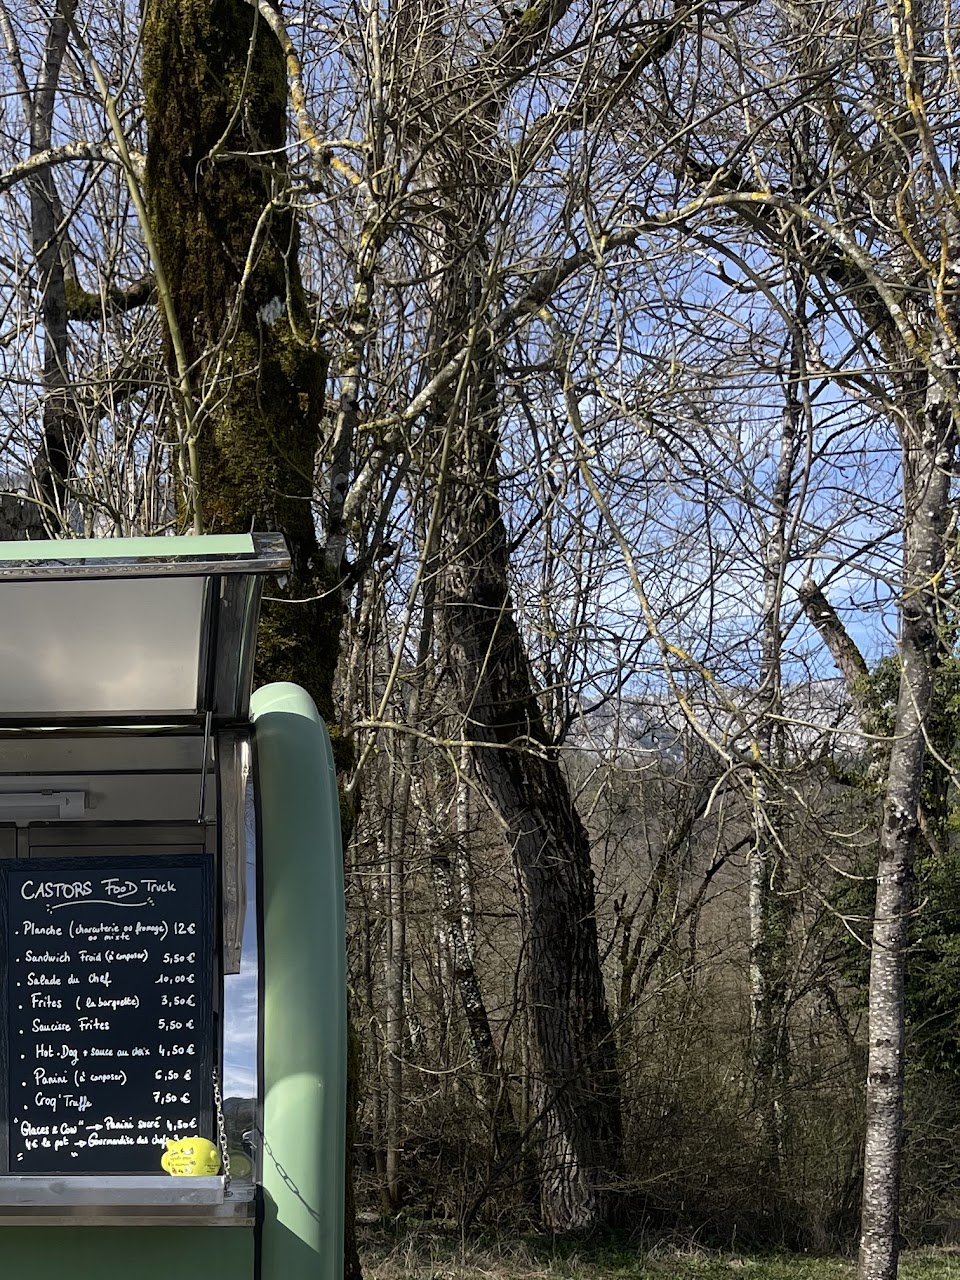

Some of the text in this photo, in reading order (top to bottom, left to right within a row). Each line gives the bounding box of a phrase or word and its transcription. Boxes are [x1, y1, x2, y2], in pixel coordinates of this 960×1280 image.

[21, 880, 92, 900] CASTORS
[23, 920, 62, 936] Planche
[174, 922, 196, 935] 12€
[104, 932, 130, 941] mixte
[25, 950, 70, 962] Sandwich
[78, 950, 101, 962] Froid
[163, 952, 195, 964] 5,50€
[27, 972, 62, 986] Salade
[67, 973, 80, 984] du
[31, 992, 62, 1009] Frites
[161, 994, 196, 1008] 3,50€
[31, 1018, 71, 1032] Saucisse
[78, 1017, 110, 1031] Frites
[90, 1047, 113, 1056] sauce
[116, 1049, 129, 1057] au
[33, 1067, 68, 1086] Panini
[104, 1116, 134, 1130] Panini
[138, 1116, 162, 1129] sucré
[54, 1136, 69, 1151] pot
